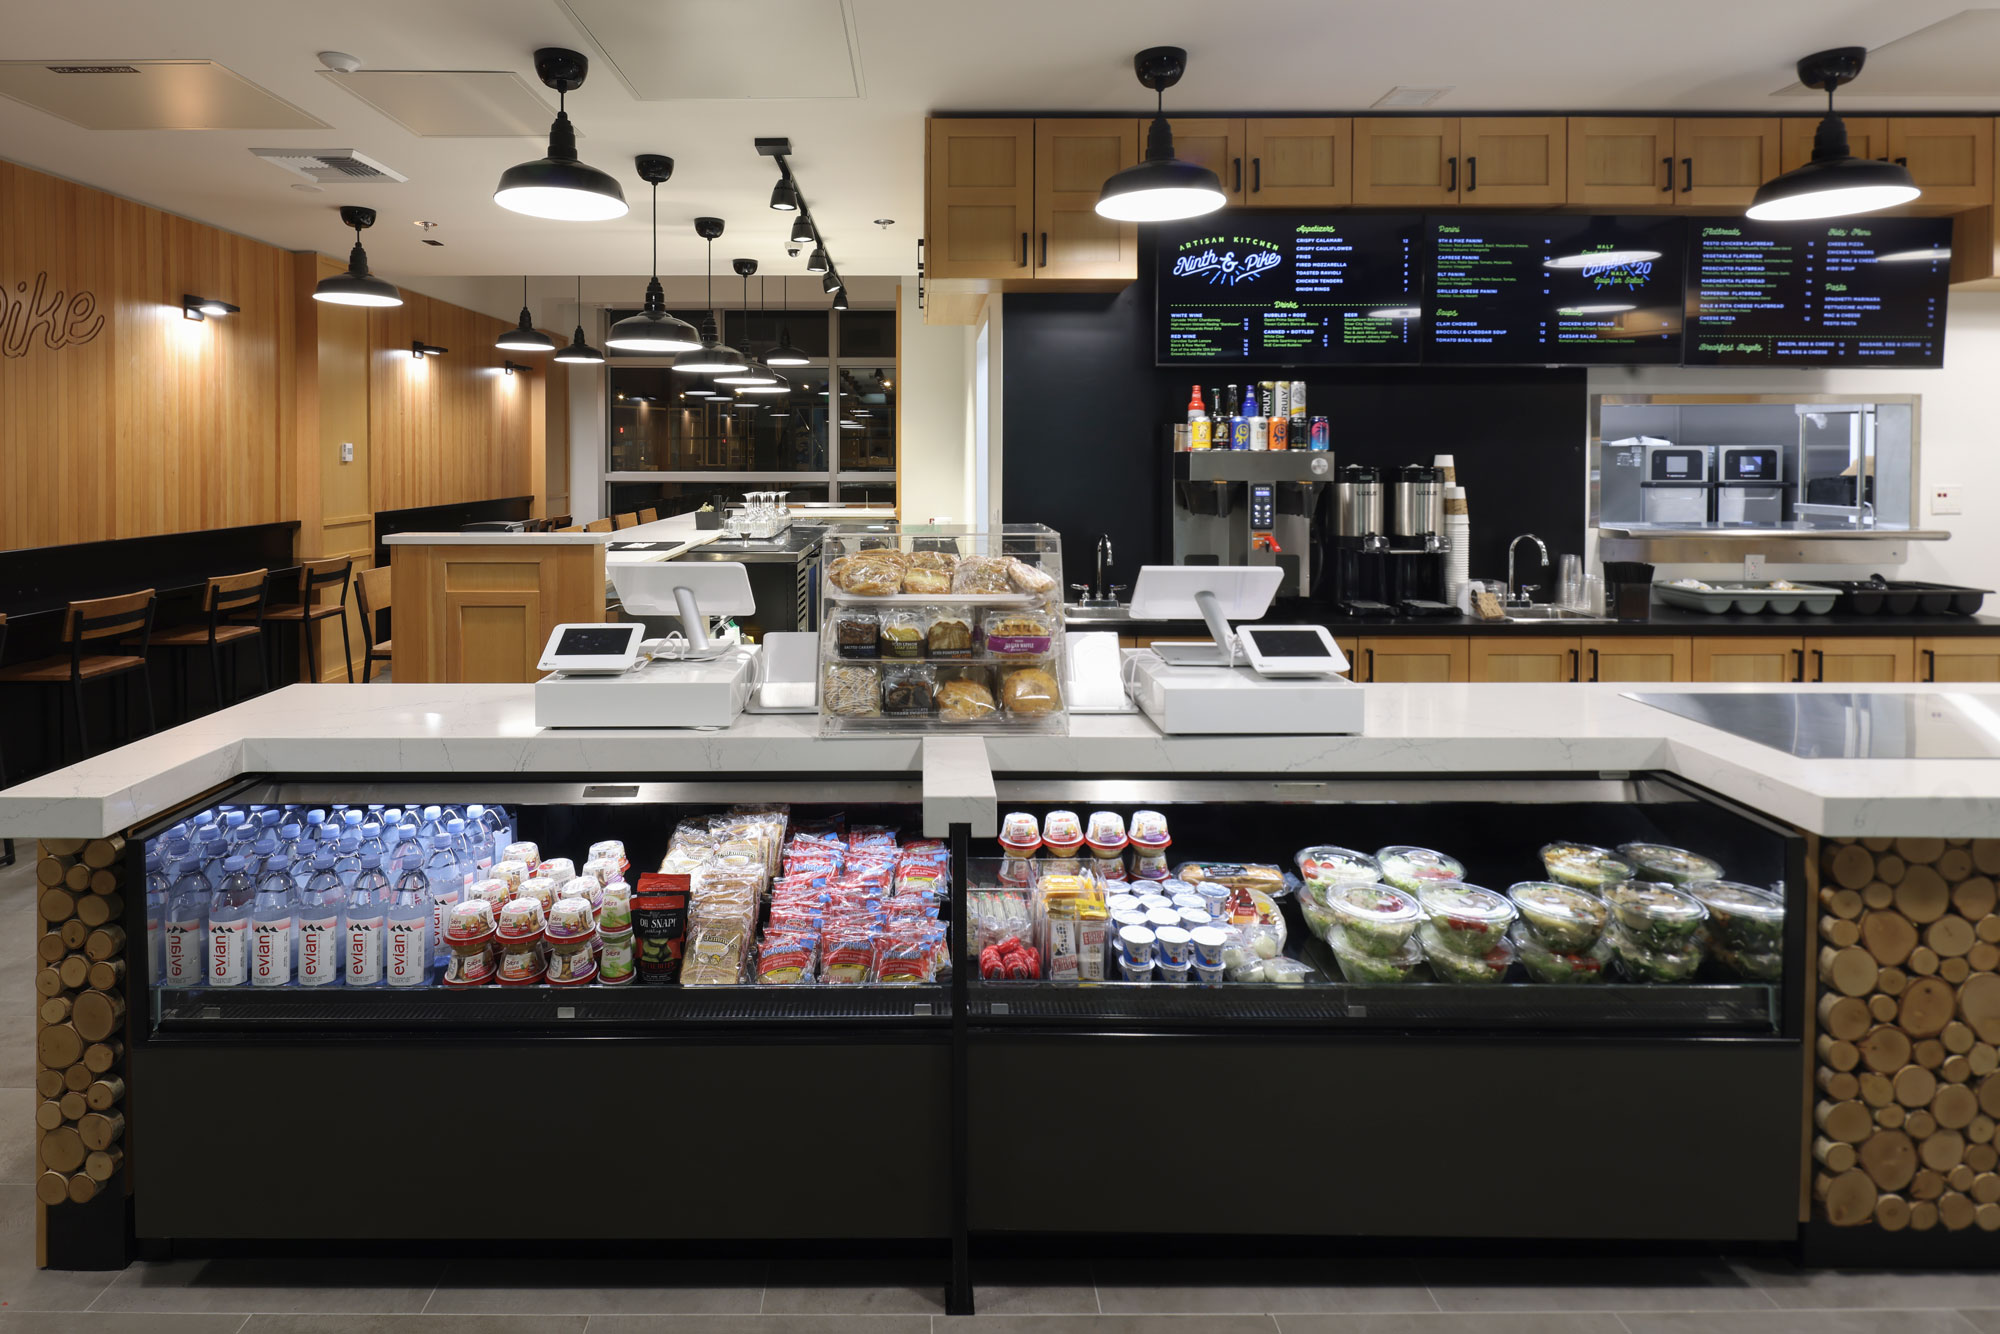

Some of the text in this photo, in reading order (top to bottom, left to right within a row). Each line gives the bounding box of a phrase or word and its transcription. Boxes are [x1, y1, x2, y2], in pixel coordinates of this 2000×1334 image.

[1173, 249, 1281, 276] Ninth & Pike
[1179, 236, 1279, 251] ARTISAN KITCHEN
[0, 271, 104, 358] ike
[1262, 390, 1272, 418] TRULY
[651, 916, 676, 928] SNAP!
[214, 935, 226, 976] evian
[257, 935, 270, 976] evian
[304, 934, 316, 975] evian
[351, 933, 363, 974] evian
[393, 934, 405, 975] evian
